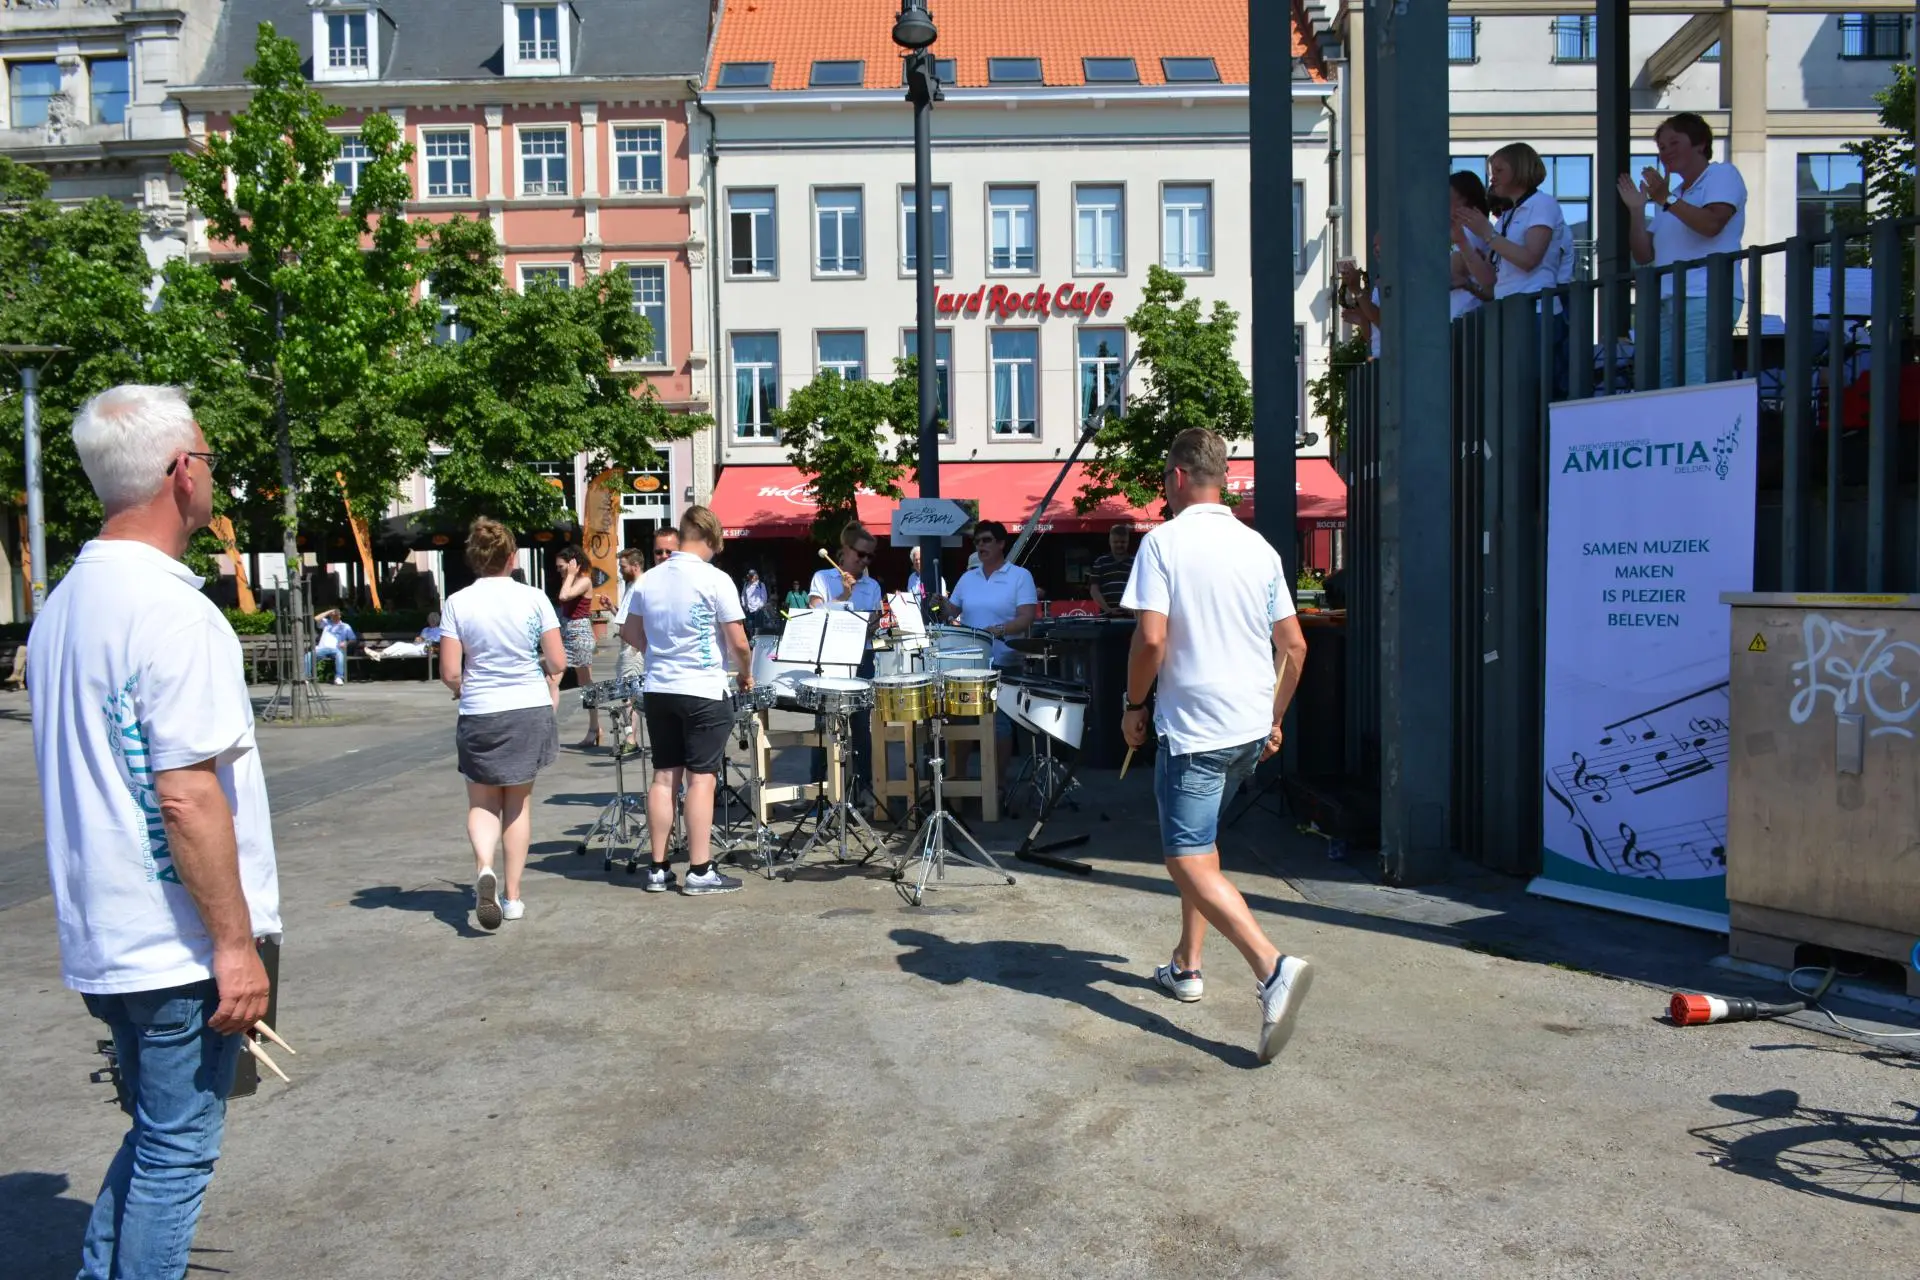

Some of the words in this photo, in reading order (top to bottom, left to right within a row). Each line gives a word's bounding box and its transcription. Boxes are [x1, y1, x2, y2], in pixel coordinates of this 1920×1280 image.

[989, 283, 1051, 318] Rock
[1055, 282, 1114, 316] Cafe
[1568, 438, 1650, 451] MUZIEKVERENIGING
[1562, 441, 1710, 474] AMICITIA
[1674, 464, 1711, 475] DELDEN
[901, 511, 955, 526] FESTIVAL
[1582, 542, 1638, 556] SAMEN
[1643, 539, 1710, 554] MUZIEK
[1615, 565, 1674, 579] MAKEN
[1602, 589, 1617, 603] IS
[1622, 589, 1686, 603] PLEZIER
[1608, 613, 1679, 627] BELEVEN
